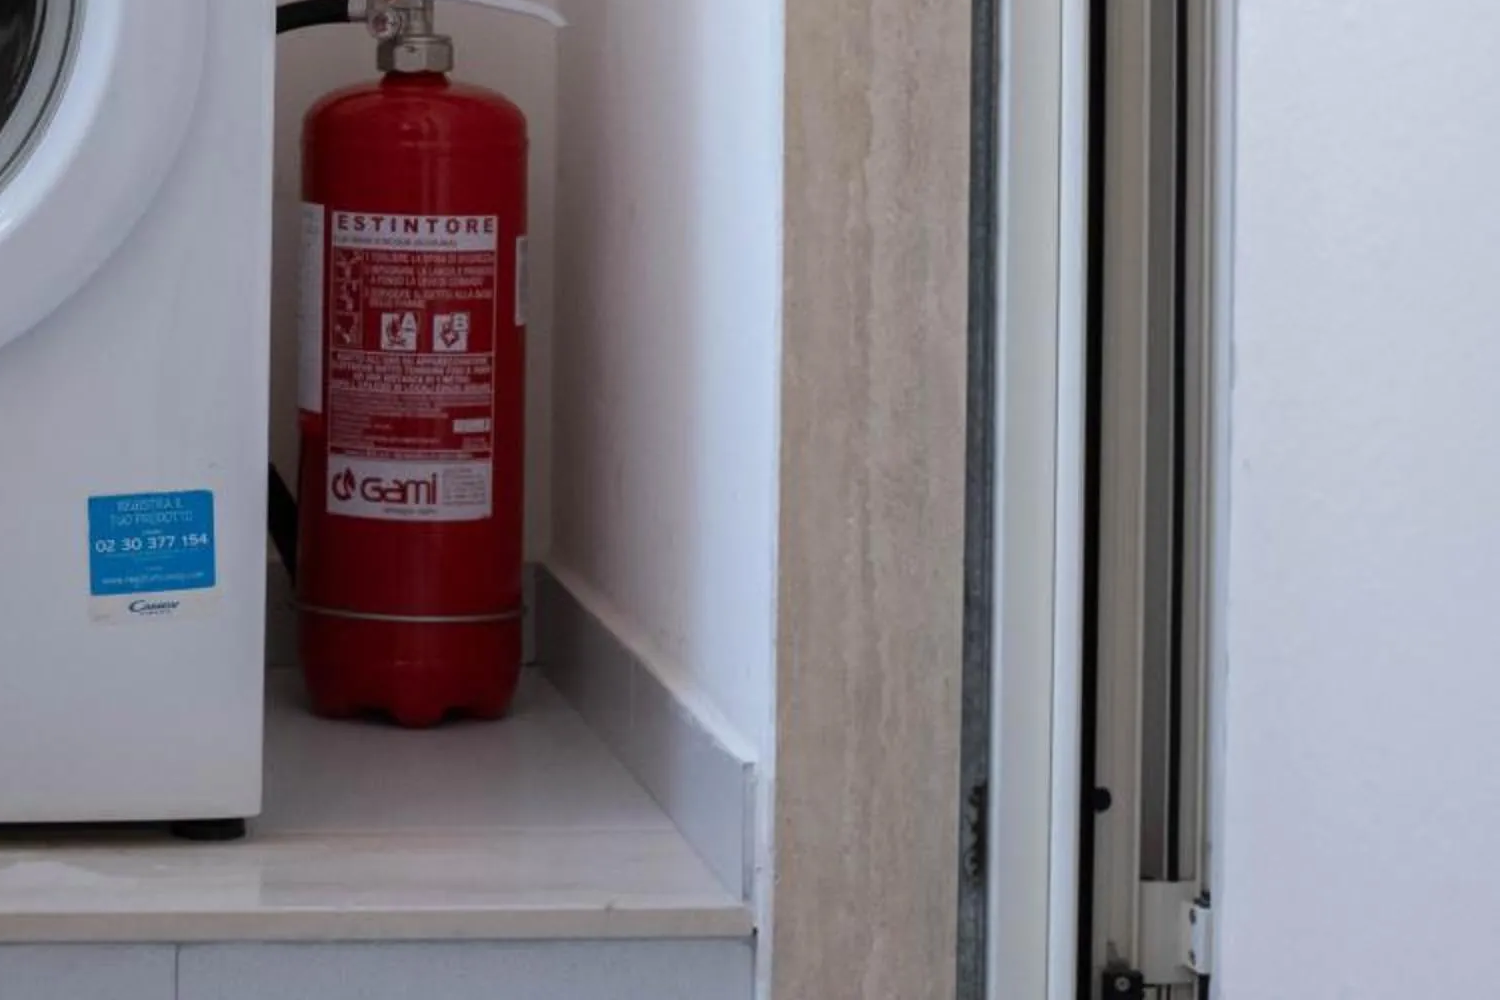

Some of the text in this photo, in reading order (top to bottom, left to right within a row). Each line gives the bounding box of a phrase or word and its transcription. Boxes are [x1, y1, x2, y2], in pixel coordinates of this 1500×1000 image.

[337, 214, 494, 234] ESTINTORE
[360, 472, 437, 505] Gami
[95, 532, 209, 553] 02 30 377 154
